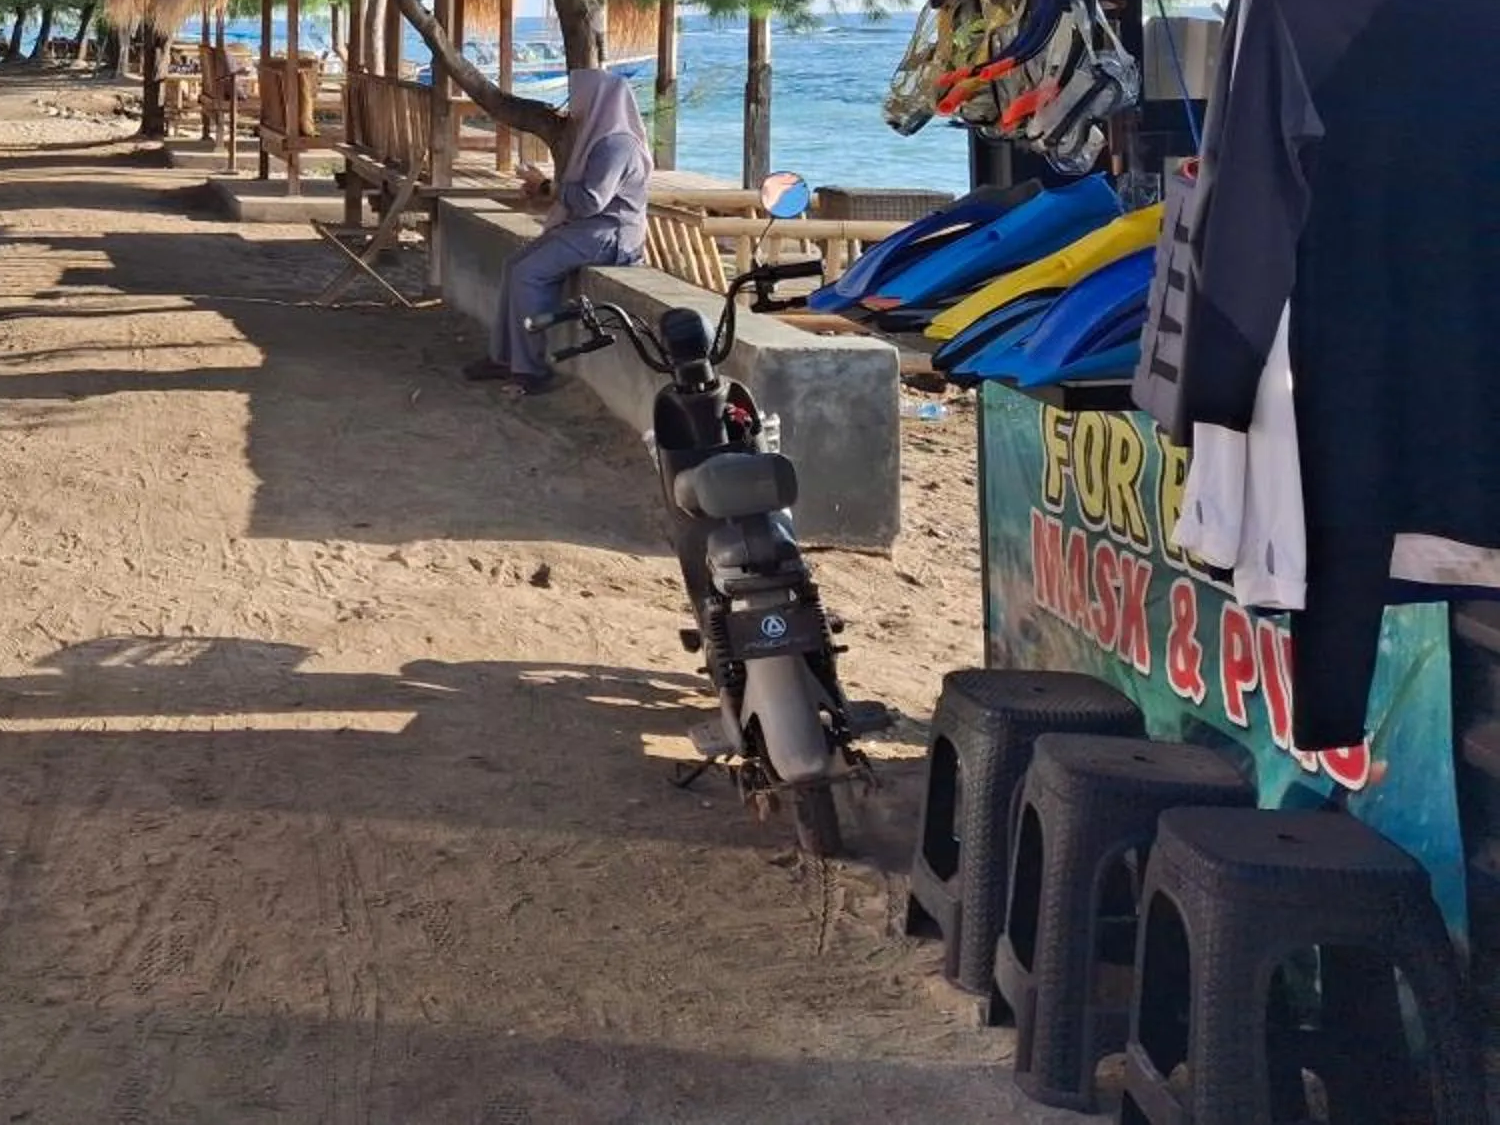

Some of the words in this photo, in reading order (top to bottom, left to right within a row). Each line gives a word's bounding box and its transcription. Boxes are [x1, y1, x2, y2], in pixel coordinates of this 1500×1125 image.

[1040, 405, 1152, 553] FOR
[1031, 507, 1152, 675] MASK
[1166, 577, 1206, 706] &
